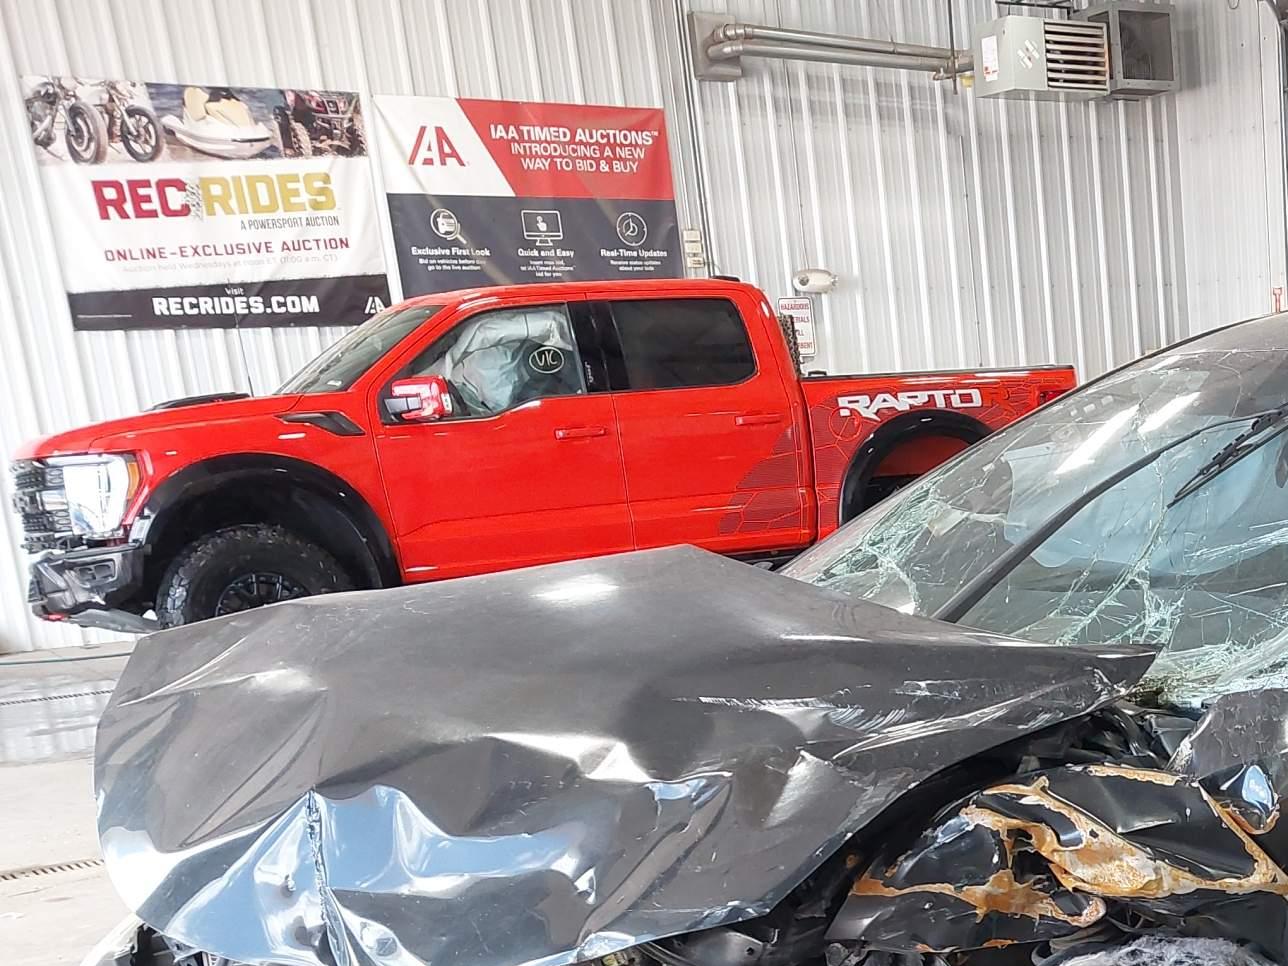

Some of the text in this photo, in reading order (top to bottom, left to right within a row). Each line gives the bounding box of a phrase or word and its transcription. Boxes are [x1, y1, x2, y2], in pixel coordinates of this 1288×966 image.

[490, 124, 518, 140] IAA
[519, 125, 571, 142] TIMED
[511, 142, 645, 159] INTRODUCING A NEW
[521, 158, 639, 173] WAY TO BID & BUY
[91, 172, 337, 220] REC RIDES
[240, 215, 340, 231] A POWERSPORT AUCTION
[104, 237, 350, 262] ONLINE-EXCLUSIVE AUCTION
[411, 246, 491, 256] Exclusive First Look
[517, 248, 575, 258] Quick and Easy
[600, 249, 667, 258] Real-Time Updates
[152, 295, 321, 316] RECRIDES.COM
